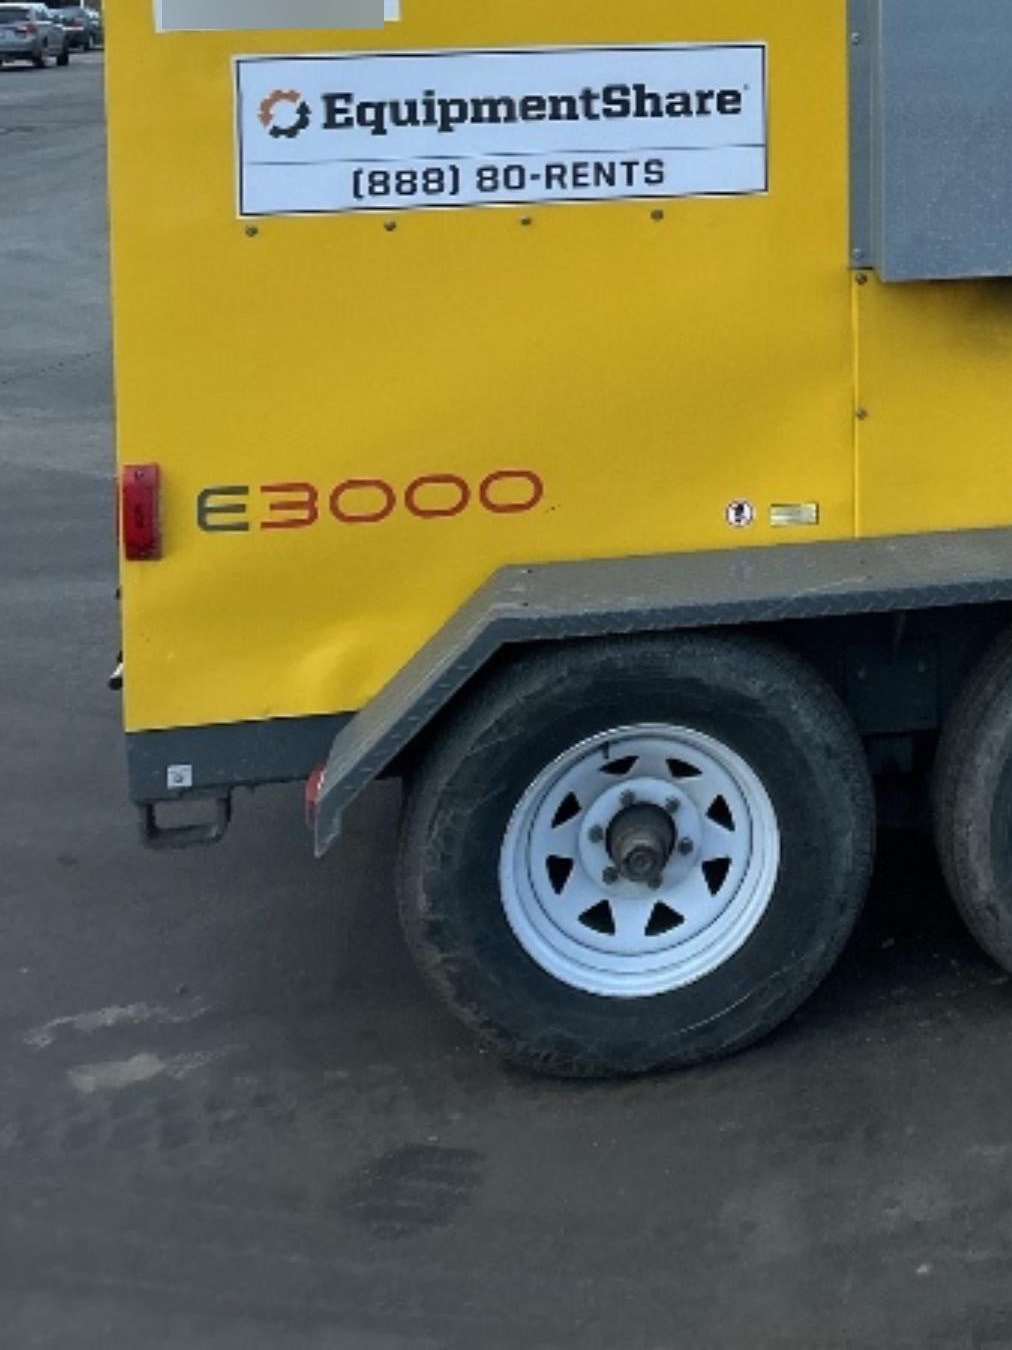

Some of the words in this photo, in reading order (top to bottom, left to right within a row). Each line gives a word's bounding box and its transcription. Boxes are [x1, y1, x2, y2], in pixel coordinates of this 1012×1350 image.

[321, 82, 743, 136] EquipmentShare
[352, 164, 461, 199] (888)
[476, 157, 665, 193] 80-RENTS
[197, 469, 544, 532] E3000
